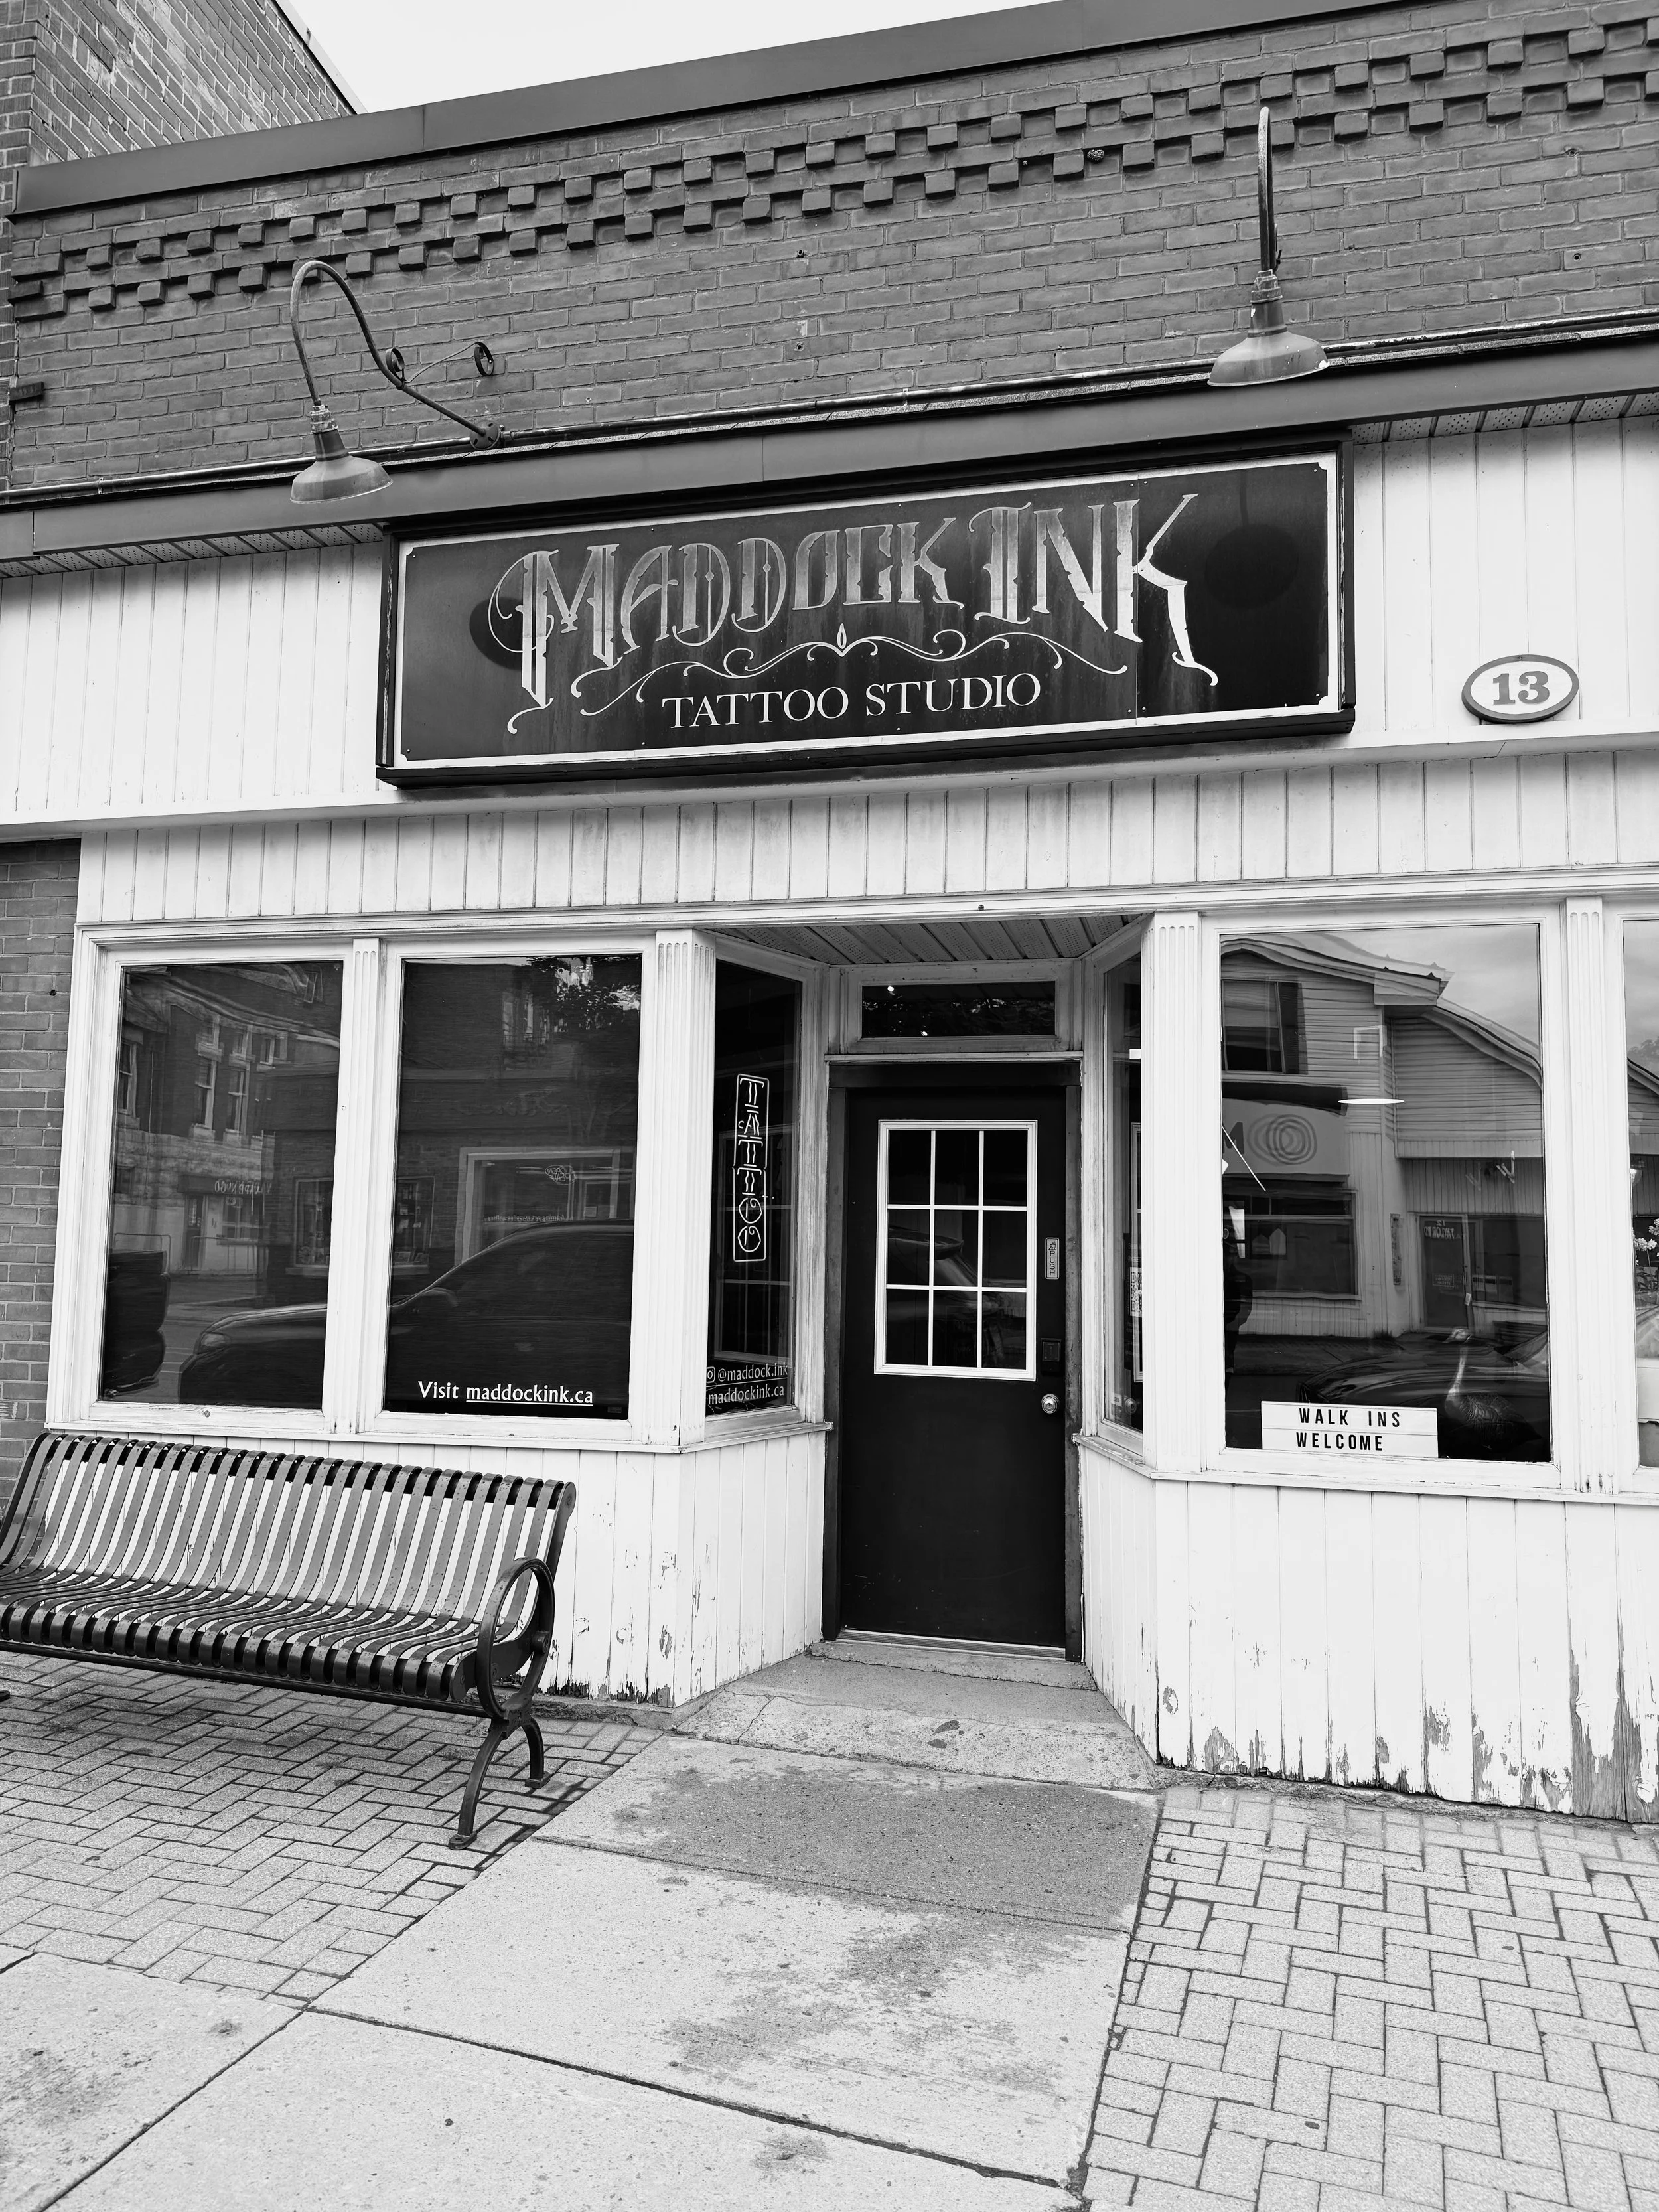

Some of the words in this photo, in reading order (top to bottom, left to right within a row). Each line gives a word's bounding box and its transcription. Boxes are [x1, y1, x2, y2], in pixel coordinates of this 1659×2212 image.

[488, 516, 964, 734] MADDOCK
[968, 493, 1218, 686] INK
[1492, 670, 1550, 706] 13
[662, 686, 849, 729] TATTOO
[865, 672, 1041, 716] STUDIO
[737, 1077, 764, 1252] TATTOO
[718, 1361, 788, 1382] @maddock.ink
[418, 1380, 459, 1399] Visit
[467, 1384, 593, 1403] maddockink.ca
[708, 1384, 784, 1405] maddockink.ca
[1299, 1408, 1348, 1426] WALK
[1368, 1410, 1400, 1427] INS
[1296, 1432, 1383, 1451] WELCOME
